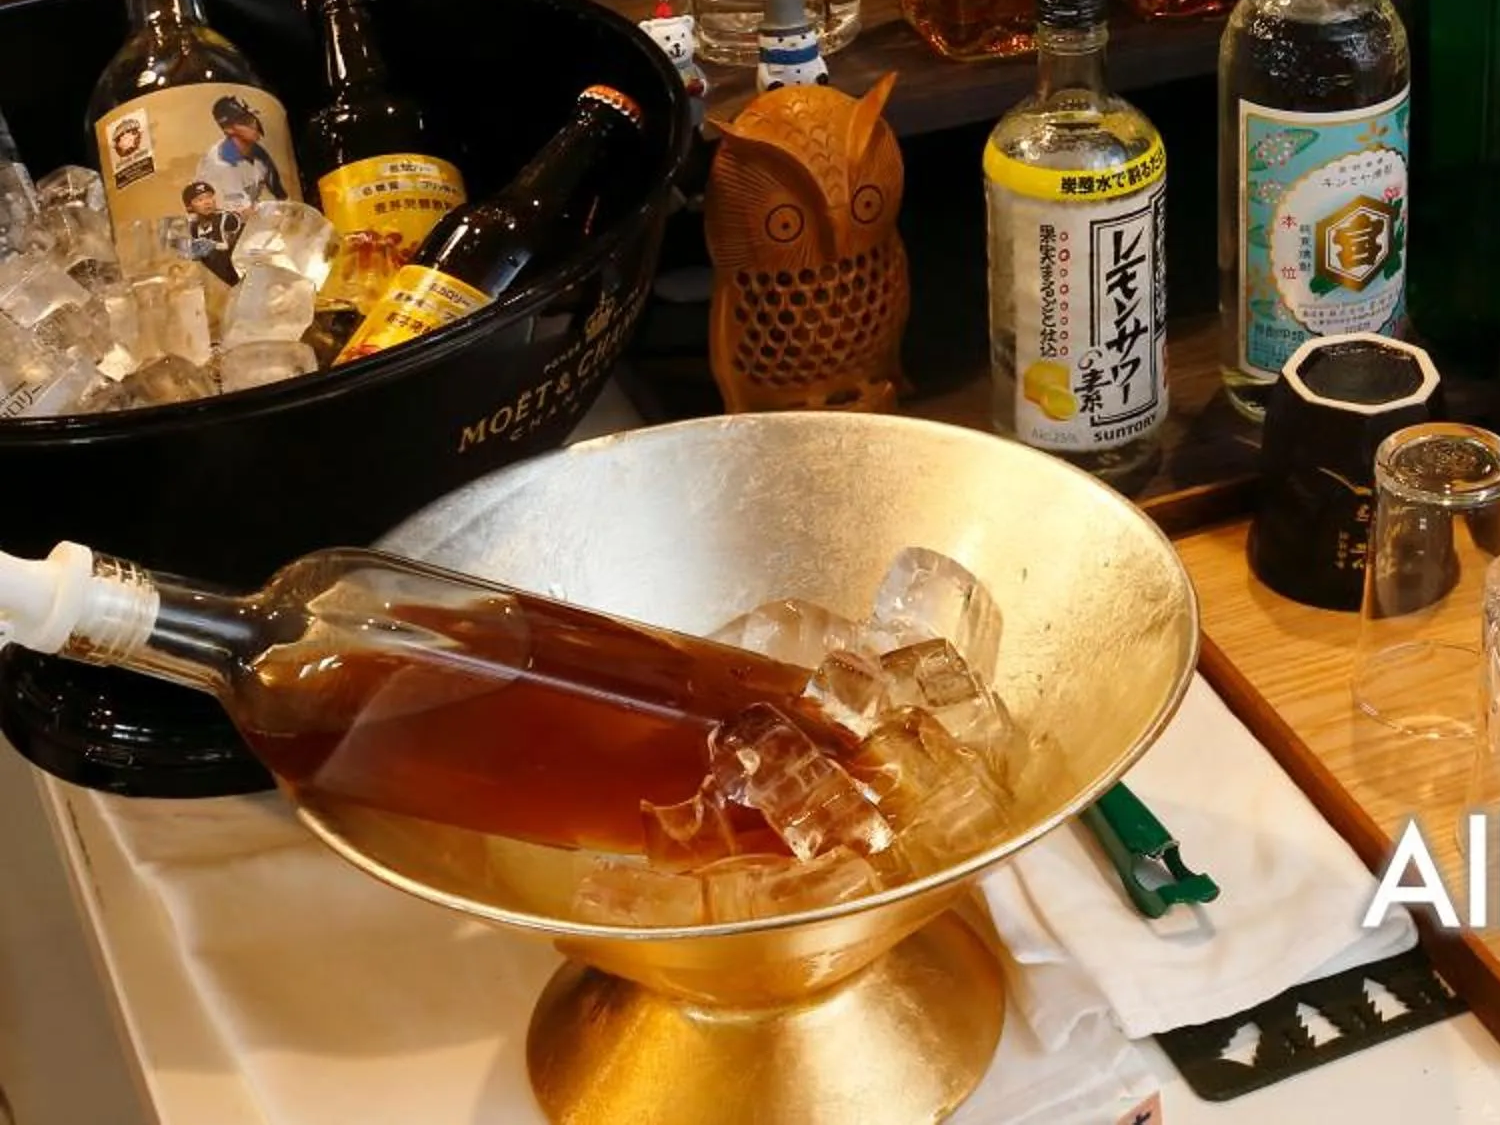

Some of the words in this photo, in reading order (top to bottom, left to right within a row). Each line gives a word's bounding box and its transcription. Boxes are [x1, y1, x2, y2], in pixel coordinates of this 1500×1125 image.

[1105, 225, 1148, 404] レモンサワー
[1093, 415, 1157, 441] SUNTORY
